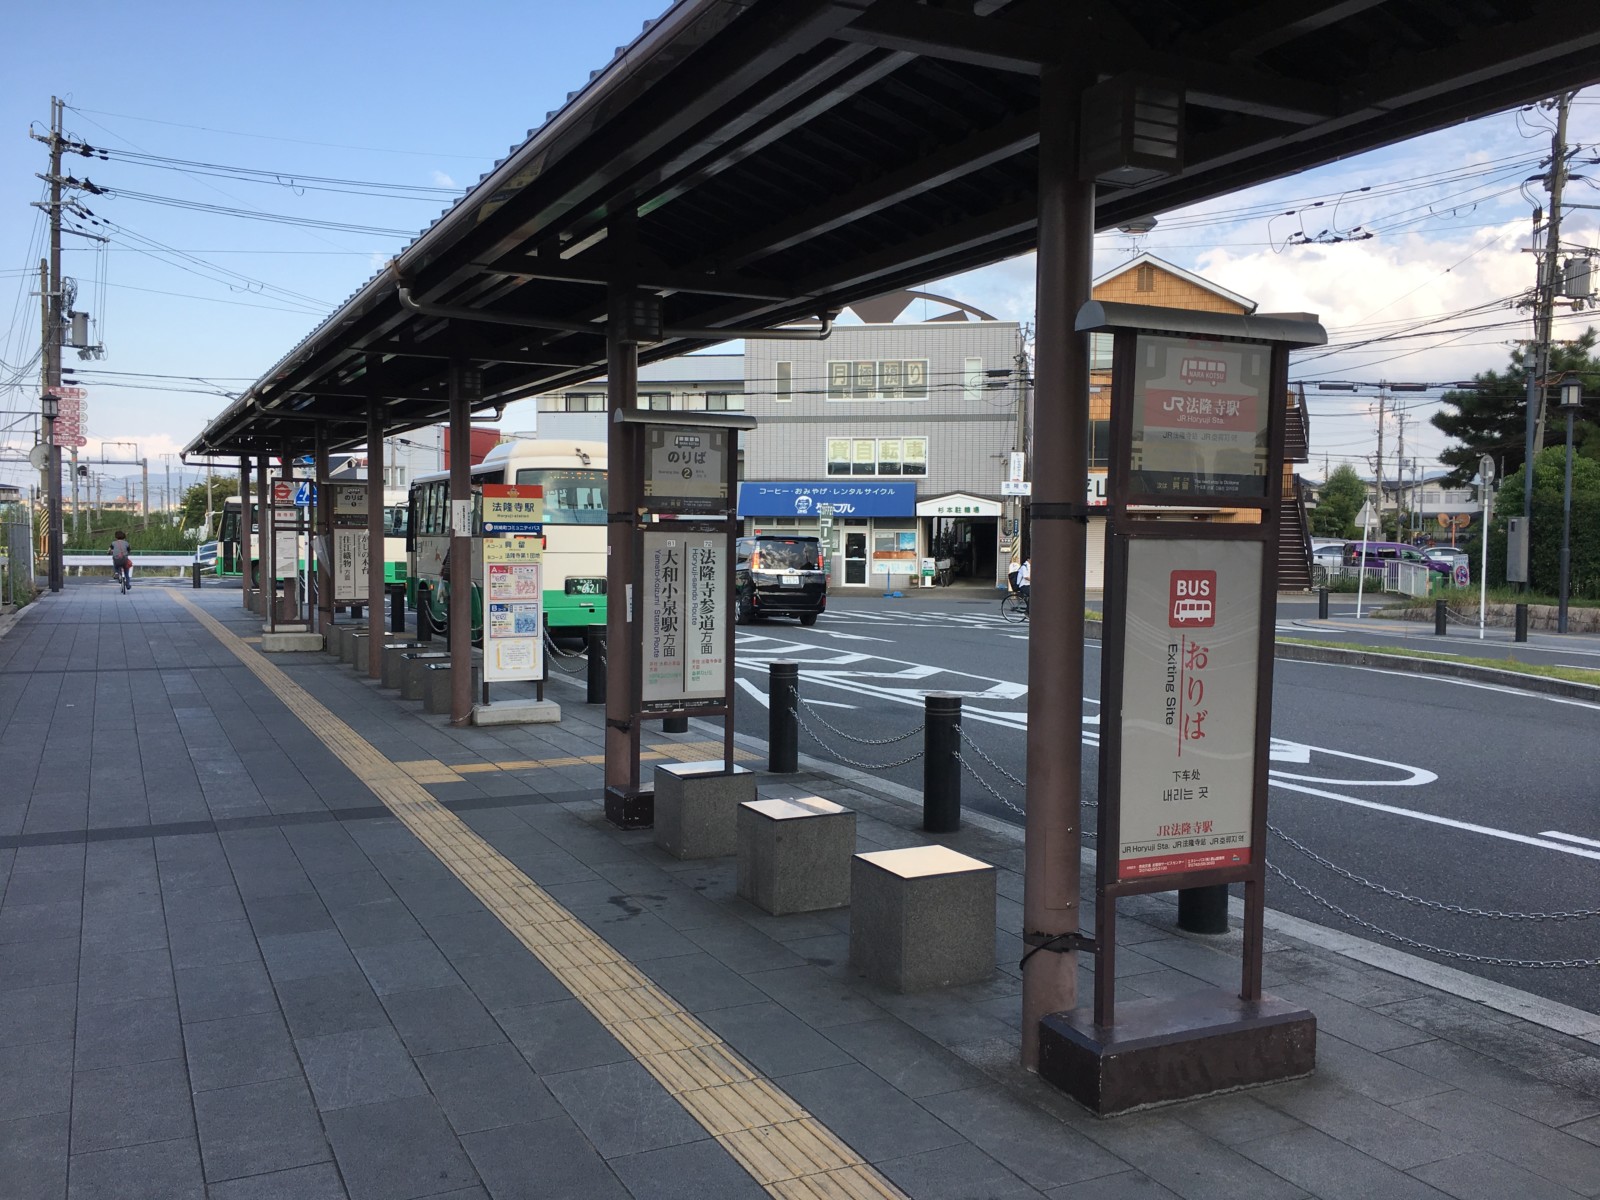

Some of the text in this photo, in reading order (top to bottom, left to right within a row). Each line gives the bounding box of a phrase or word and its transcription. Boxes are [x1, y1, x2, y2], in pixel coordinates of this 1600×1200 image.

[1189, 370, 1225, 380] NARA KOTSU
[1163, 396, 1240, 416] JR法隆寺駅
[1177, 414, 1187, 422] JR
[1187, 415, 1211, 425] Horyuji
[667, 451, 707, 464] のりば
[831, 441, 924, 459] 貸自転車
[683, 468, 690, 478] 2
[759, 487, 896, 496] コーヒー・おみやげ・レンタルサイクル
[492, 502, 534, 512] 法隆寺駅
[821, 518, 831, 557] コーヒー
[1176, 580, 1210, 596] BUS
[661, 549, 678, 657] 大和小泉駅方面
[698, 549, 716, 654] 法隆寺参道方面
[1165, 643, 1178, 725] Exiting Site
[1184, 641, 1209, 740] おりば
[1172, 769, 1201, 782] 下车处
[1163, 786, 1209, 802] 내리는 곳
[1156, 820, 1213, 837] JR法隆寺駅
[1121, 842, 1170, 854] JR Horyuji Sta.
